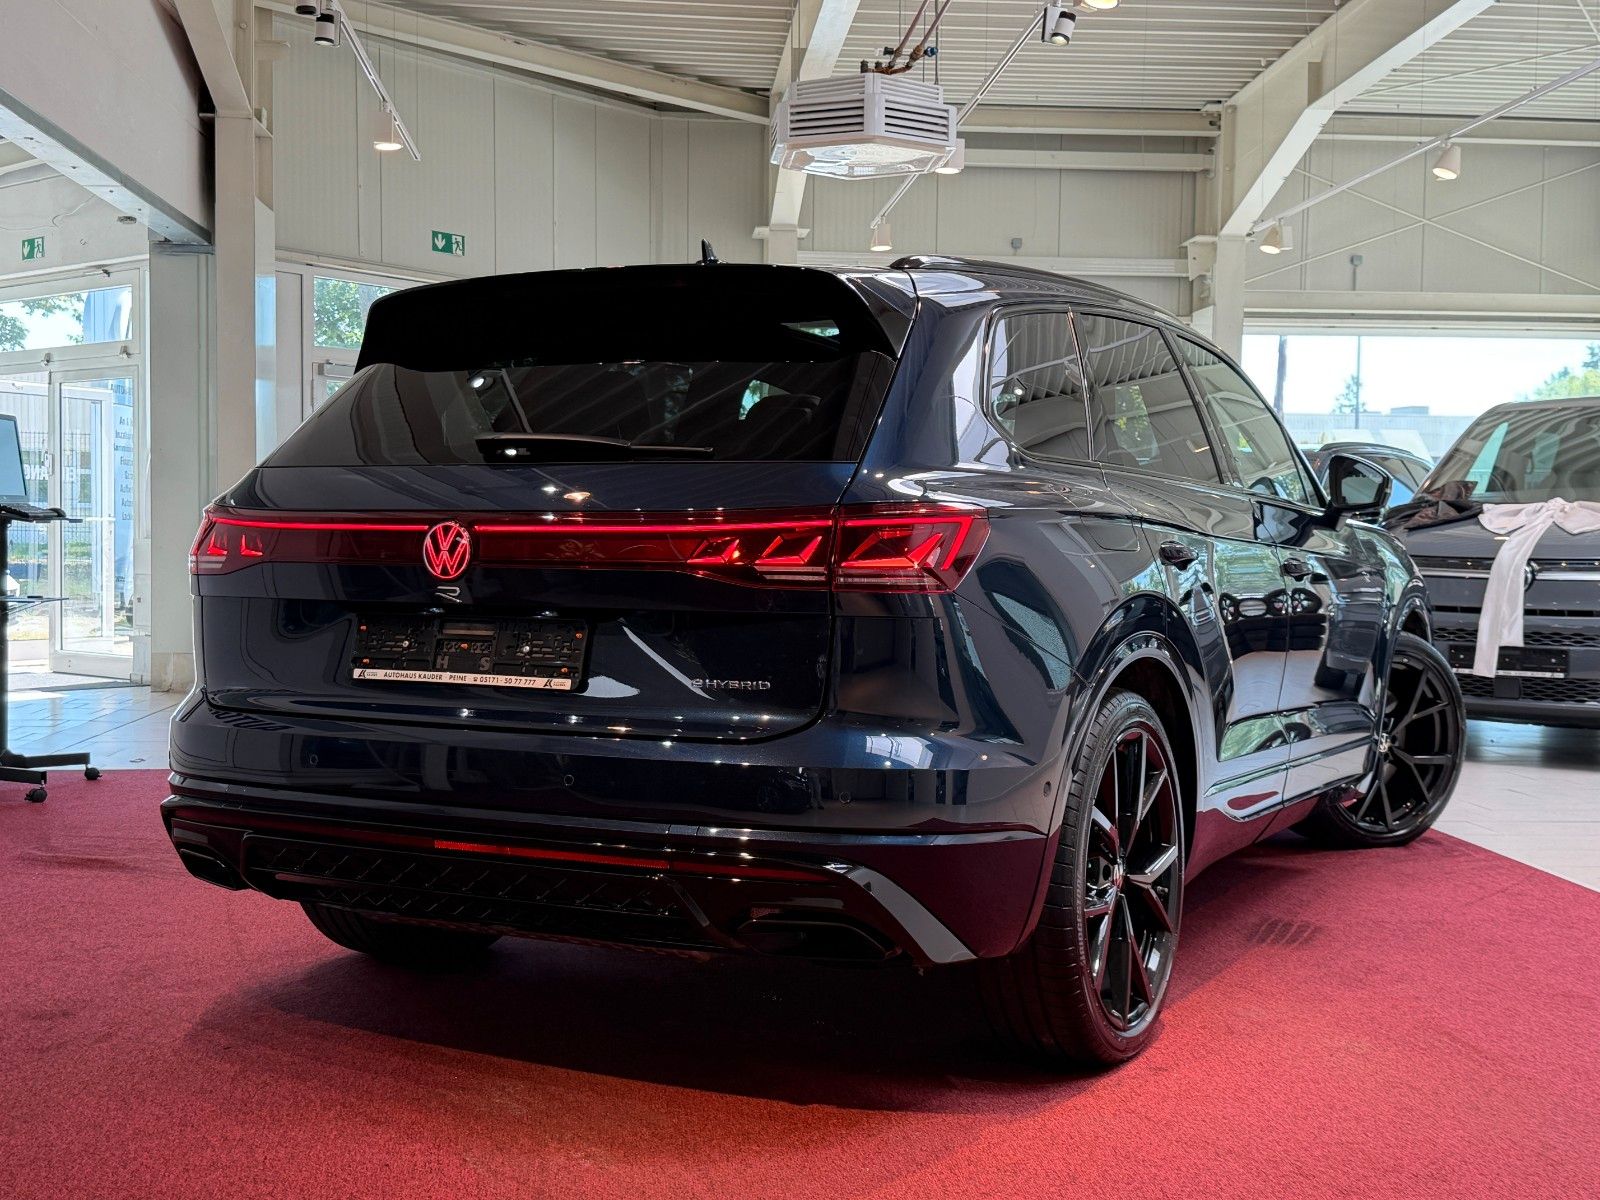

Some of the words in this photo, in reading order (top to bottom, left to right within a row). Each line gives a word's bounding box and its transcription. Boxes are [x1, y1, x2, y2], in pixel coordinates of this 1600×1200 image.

[435, 586, 462, 602] R
[383, 671, 417, 680] AUTOHAUS
[418, 673, 443, 681] KAUDER
[448, 674, 467, 682] PEINE
